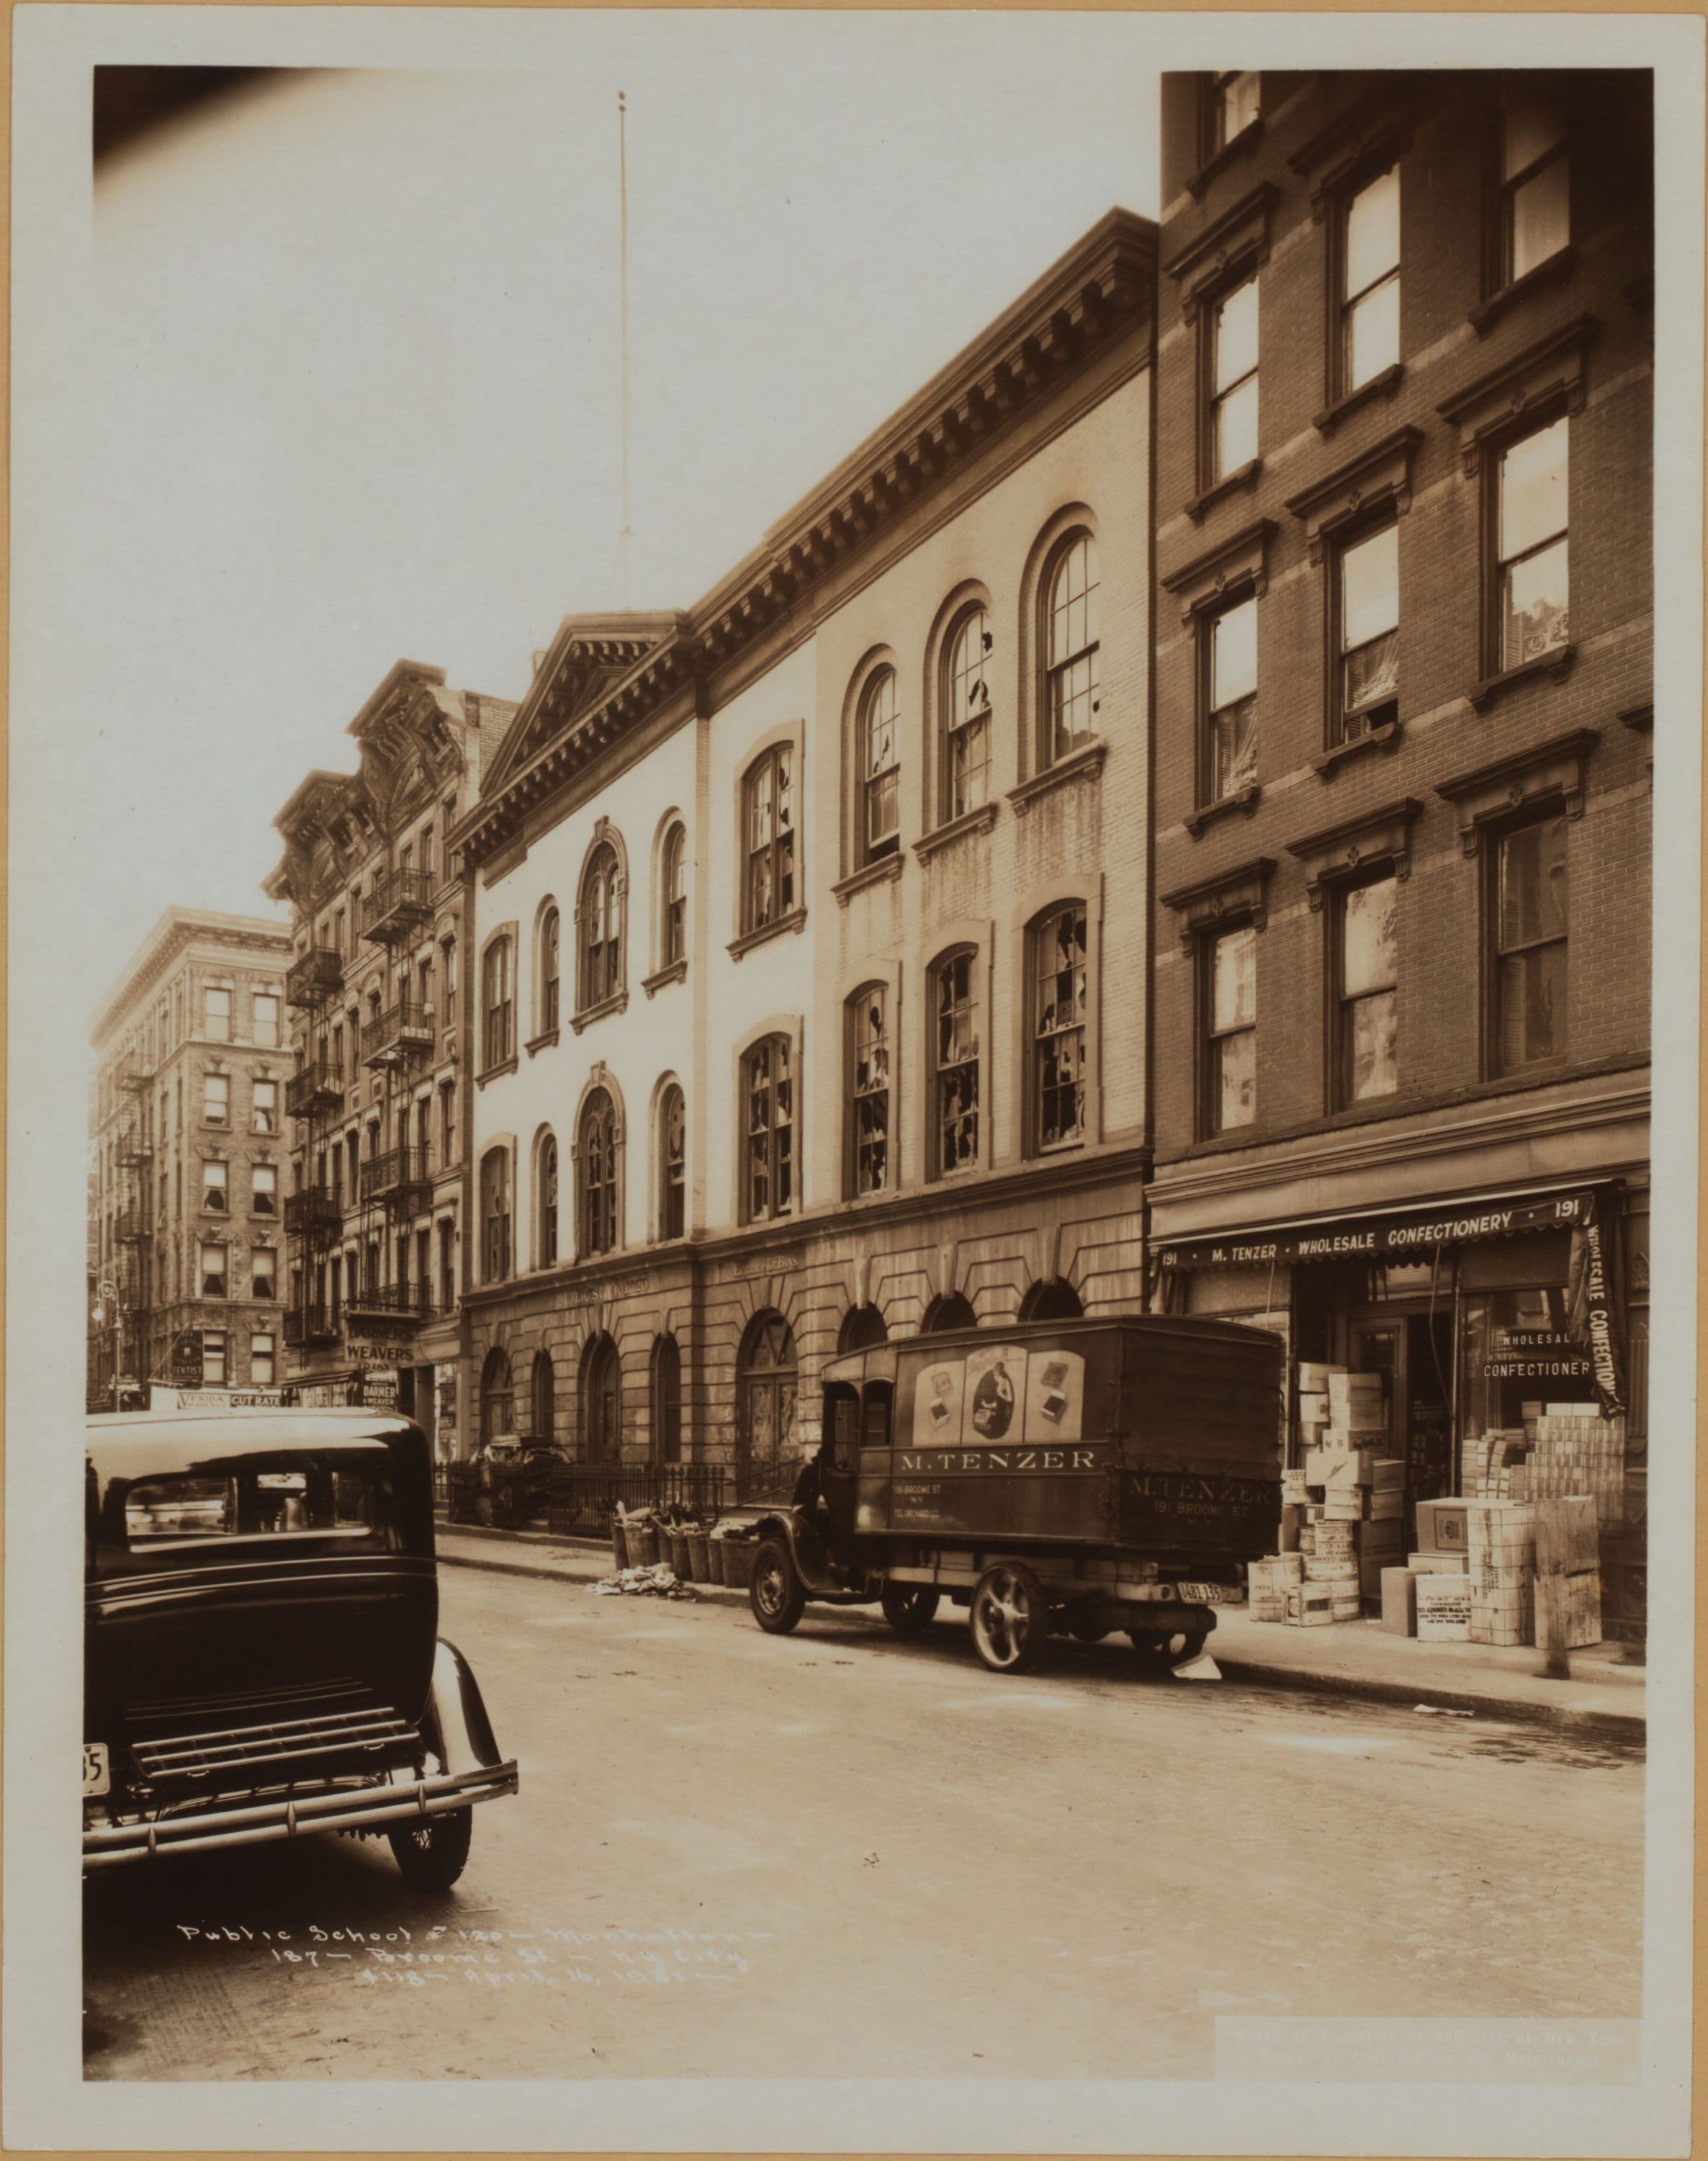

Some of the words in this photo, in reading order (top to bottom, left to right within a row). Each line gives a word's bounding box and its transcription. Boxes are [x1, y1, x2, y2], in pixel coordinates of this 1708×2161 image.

[1162, 1252, 1177, 1265] 191
[1212, 1248, 1227, 1262] M.
[1231, 1244, 1277, 1262] TENZER
[1298, 1232, 1375, 1255] WHOLESALE
[1388, 1210, 1512, 1246] CONFECTIONERY
[1555, 1199, 1579, 1218] 191
[347, 1345, 414, 1360] WEAVERS
[1589, 1309, 1617, 1398] CONFECTION
[231, 1396, 253, 1405] CUT
[254, 1396, 281, 1406] RATE
[363, 1385, 395, 1398] DARNER
[938, 1451, 1096, 1470] TENZER
[1158, 1476, 1270, 1504] TENZER
